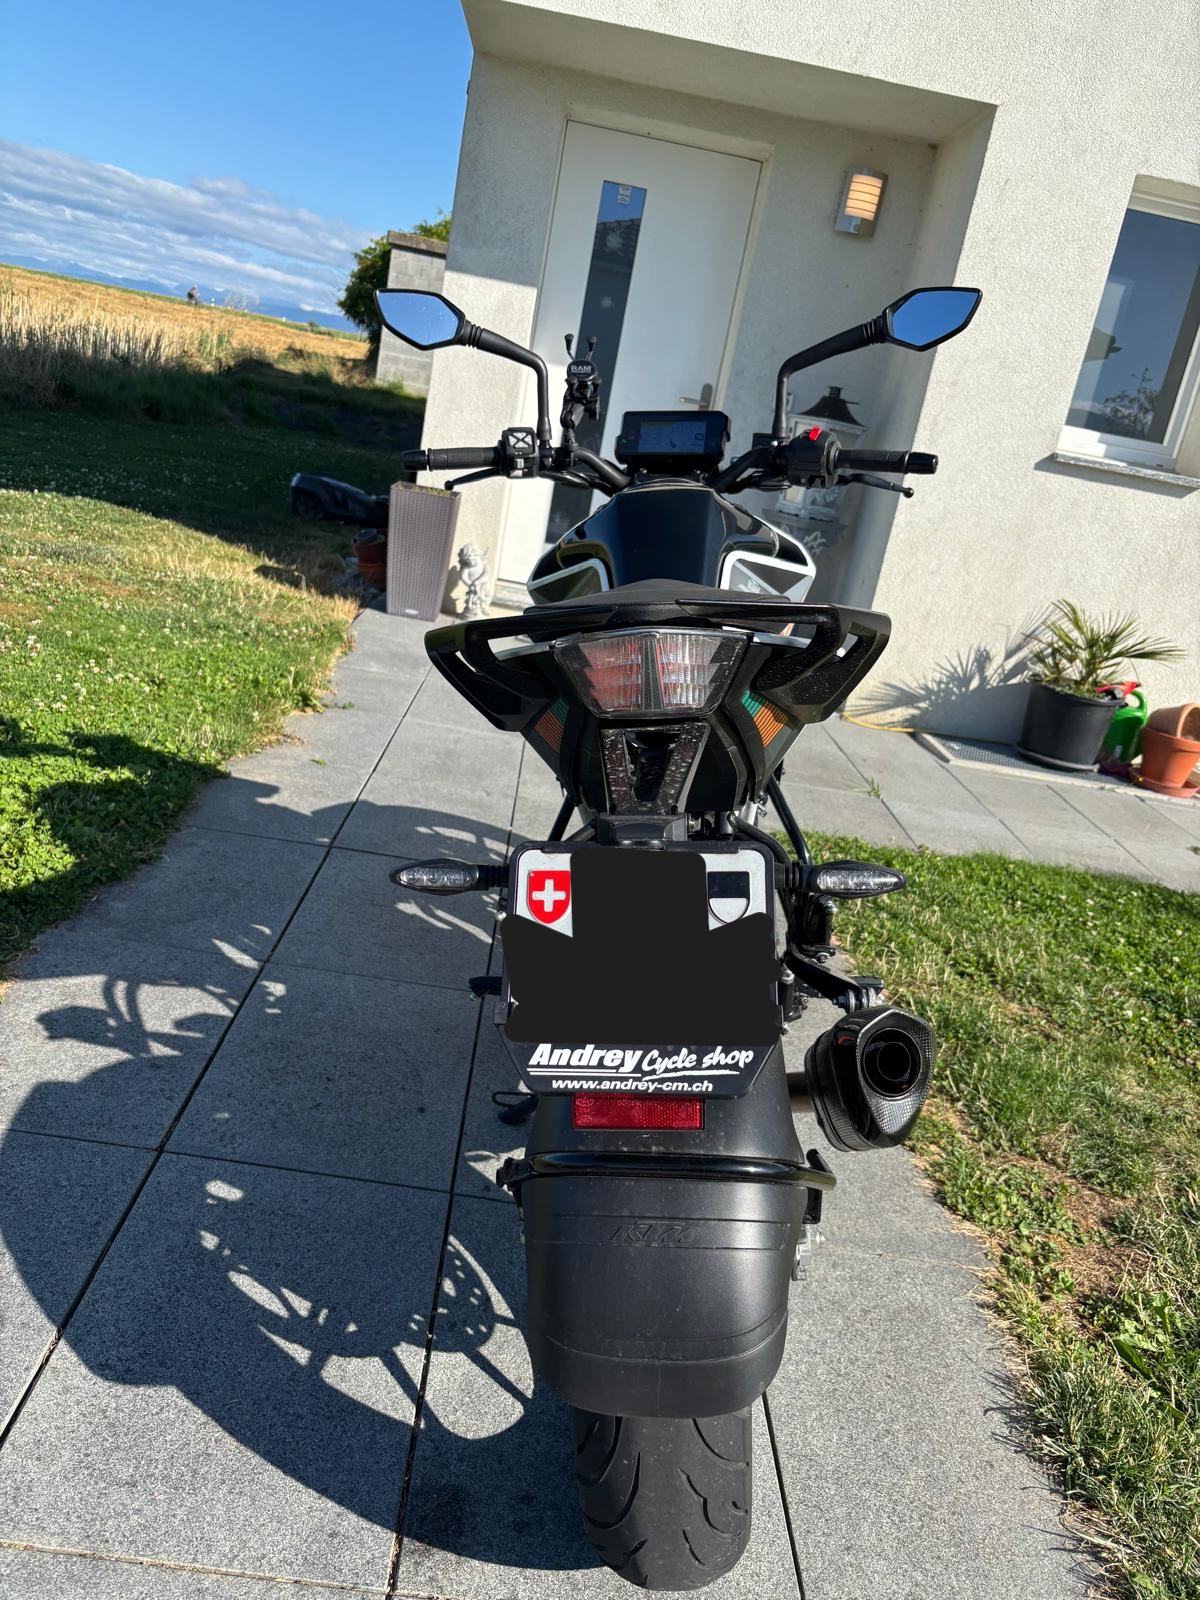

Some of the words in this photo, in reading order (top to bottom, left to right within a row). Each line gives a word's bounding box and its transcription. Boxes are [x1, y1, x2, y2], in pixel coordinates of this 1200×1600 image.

[529, 1043, 643, 1072] Andrey
[641, 1047, 697, 1075] Cycle
[701, 1046, 755, 1069] shop
[551, 1078, 714, 1093] www.andrey-cm.ch
